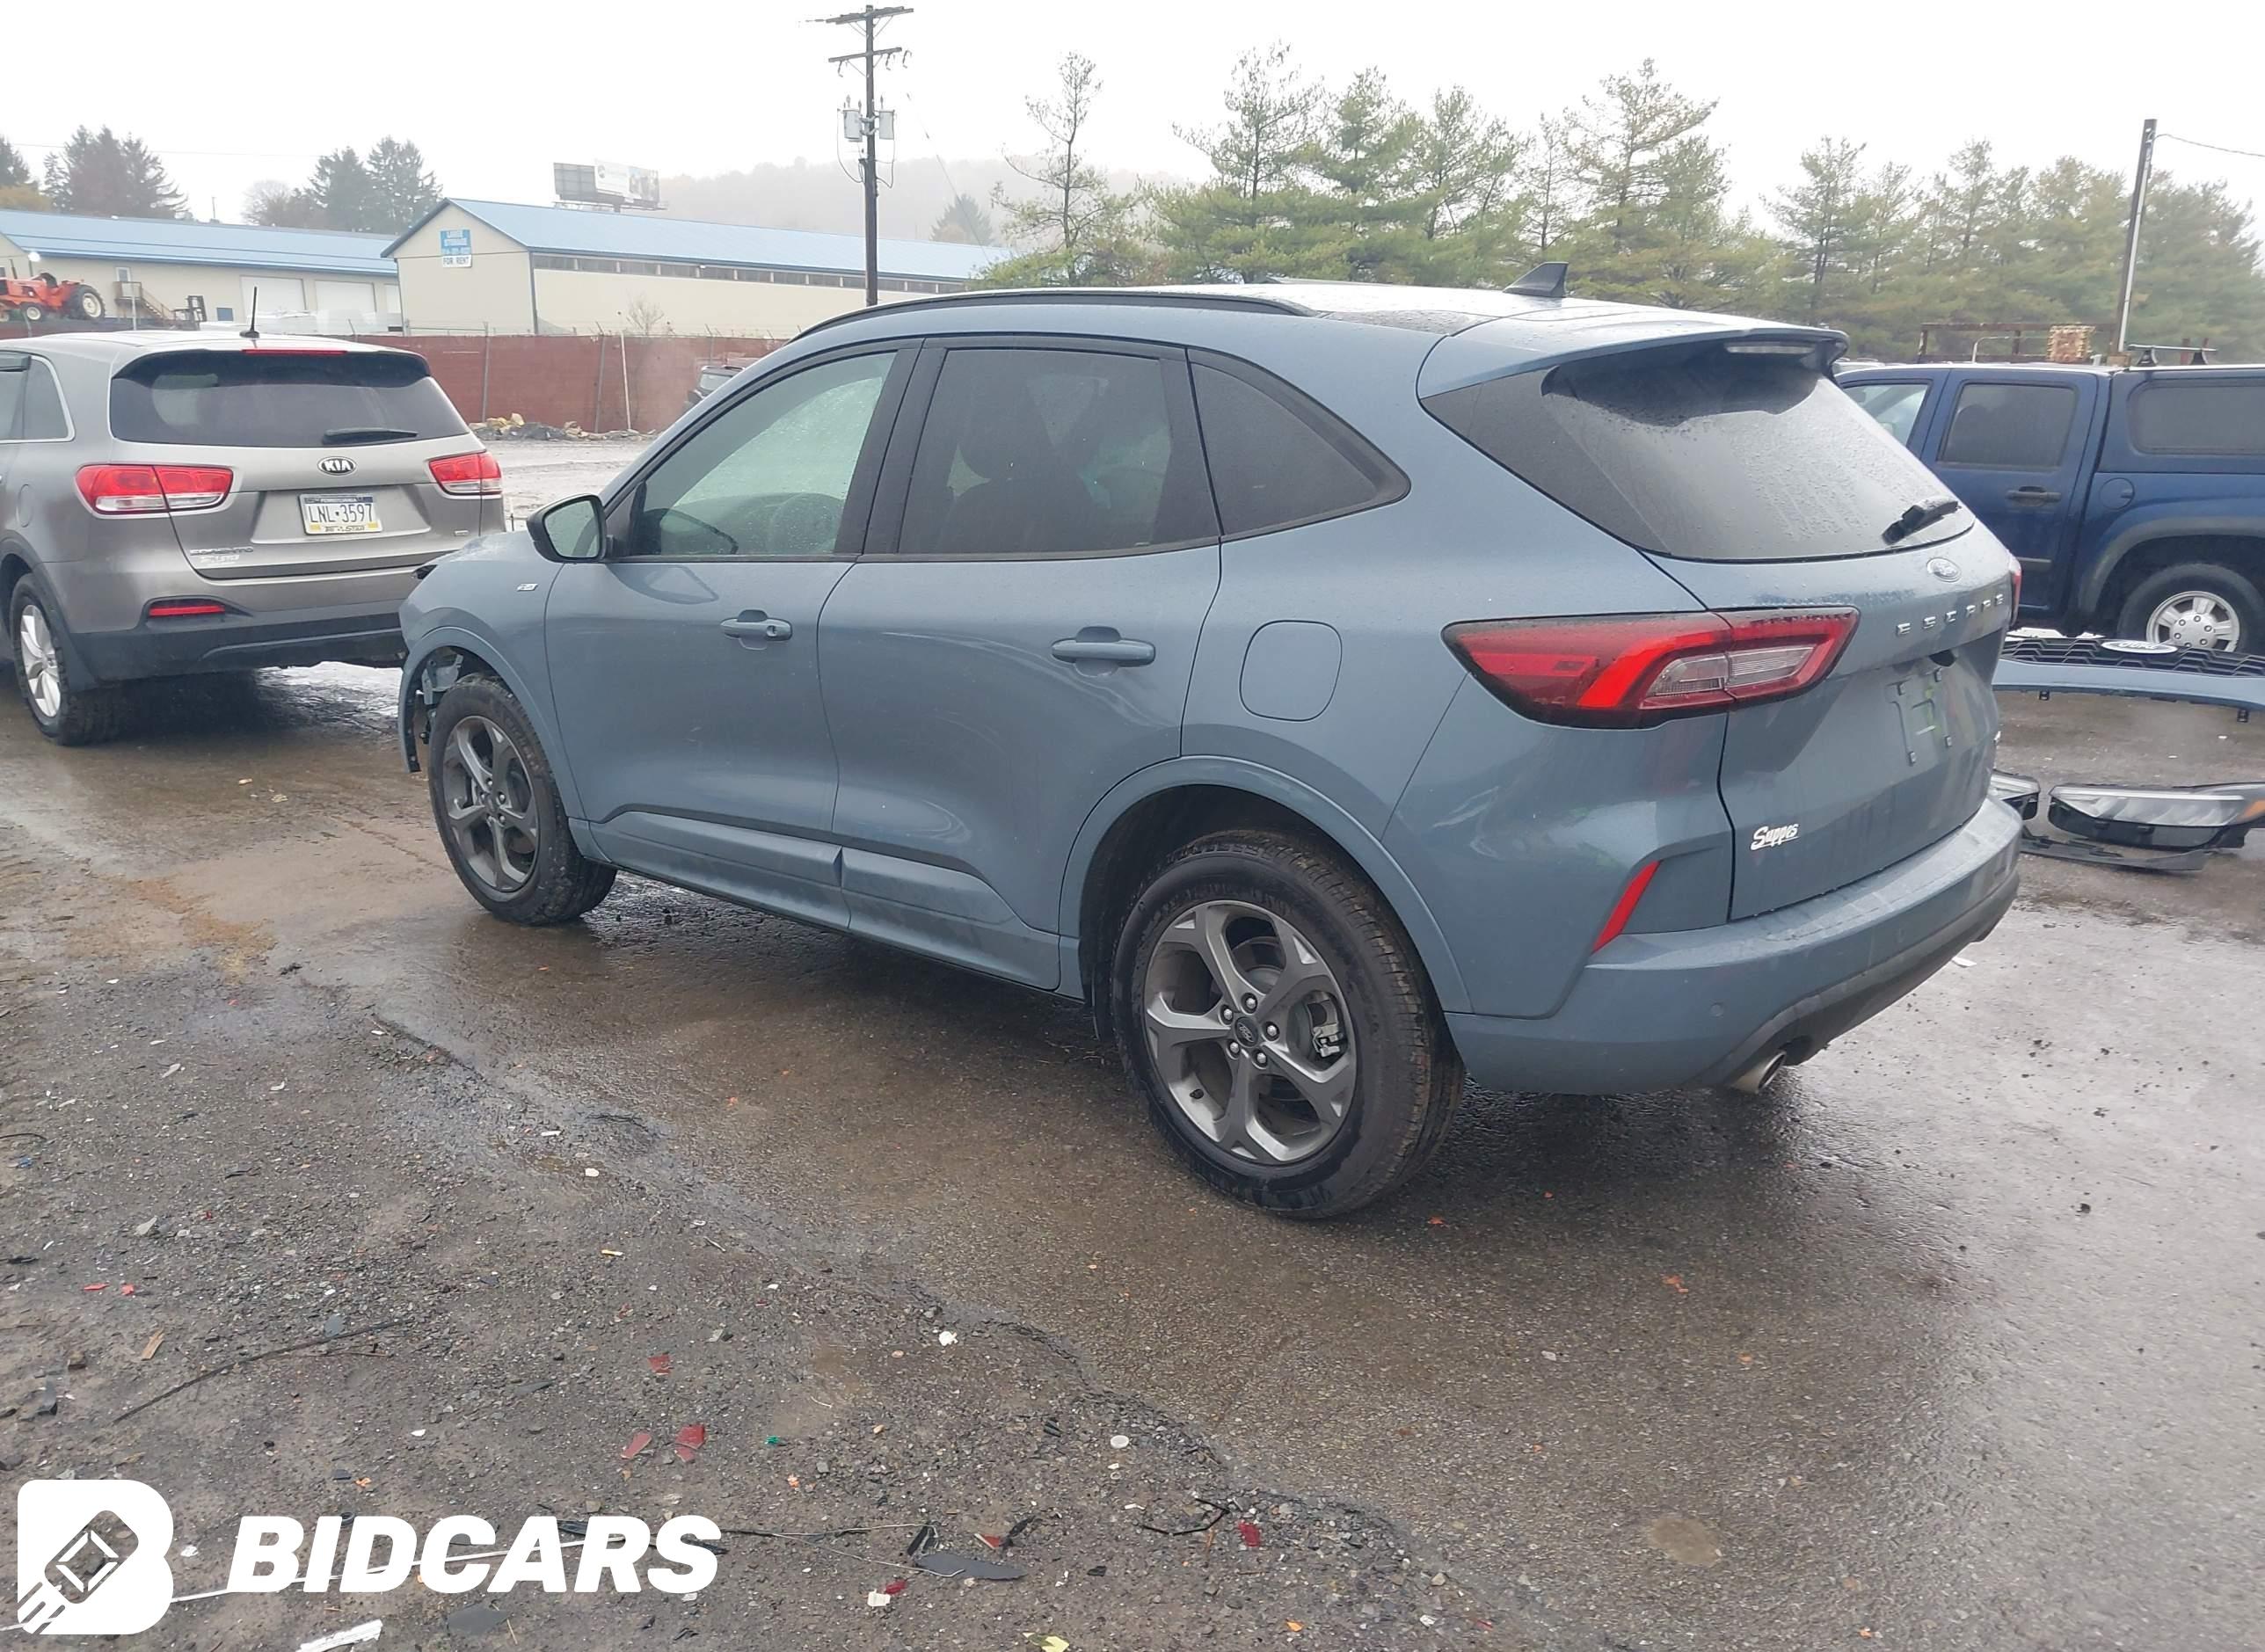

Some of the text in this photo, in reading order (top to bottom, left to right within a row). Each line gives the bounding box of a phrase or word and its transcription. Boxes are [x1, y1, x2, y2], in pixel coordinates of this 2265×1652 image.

[455, 256, 470, 265] RENT
[323, 459, 352, 472] KIA
[309, 503, 373, 523] LNL 3597
[1896, 593, 2005, 636] ESCAPE
